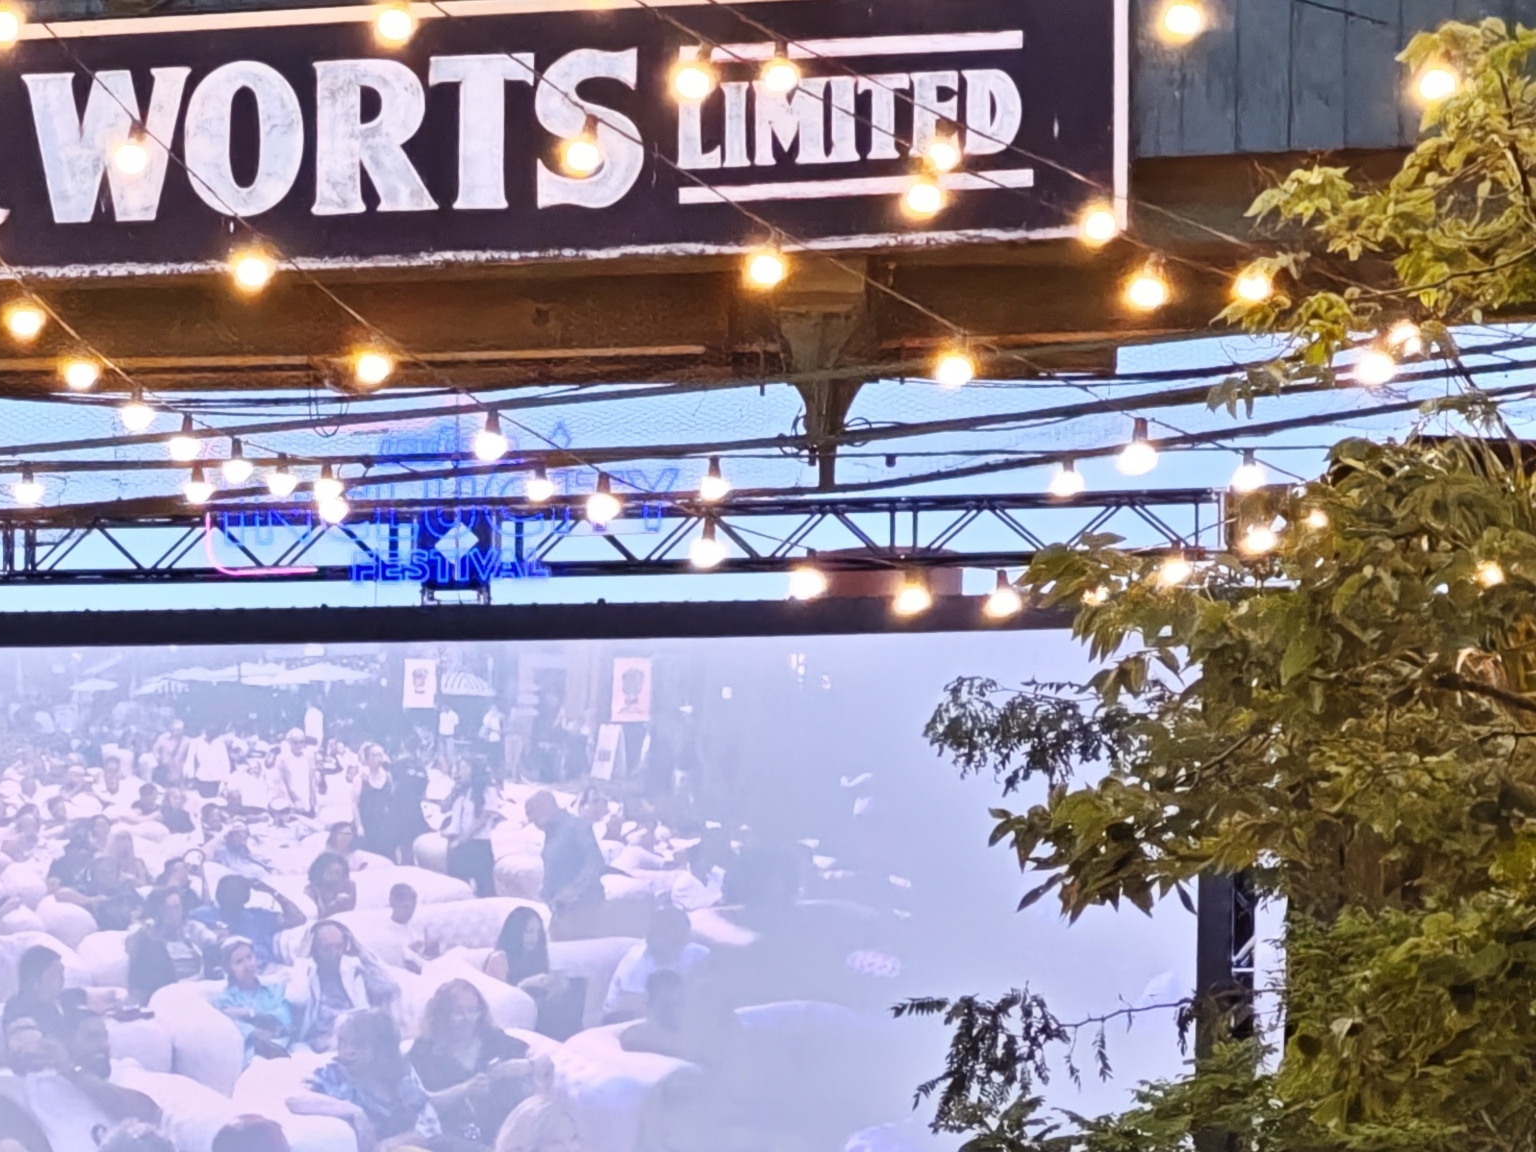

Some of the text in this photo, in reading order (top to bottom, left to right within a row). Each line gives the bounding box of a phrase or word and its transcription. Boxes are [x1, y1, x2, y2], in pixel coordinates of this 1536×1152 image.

[21, 47, 644, 224] WORTS
[678, 68, 1024, 170] LIMITED
[350, 548, 551, 583] FESTIVAL
